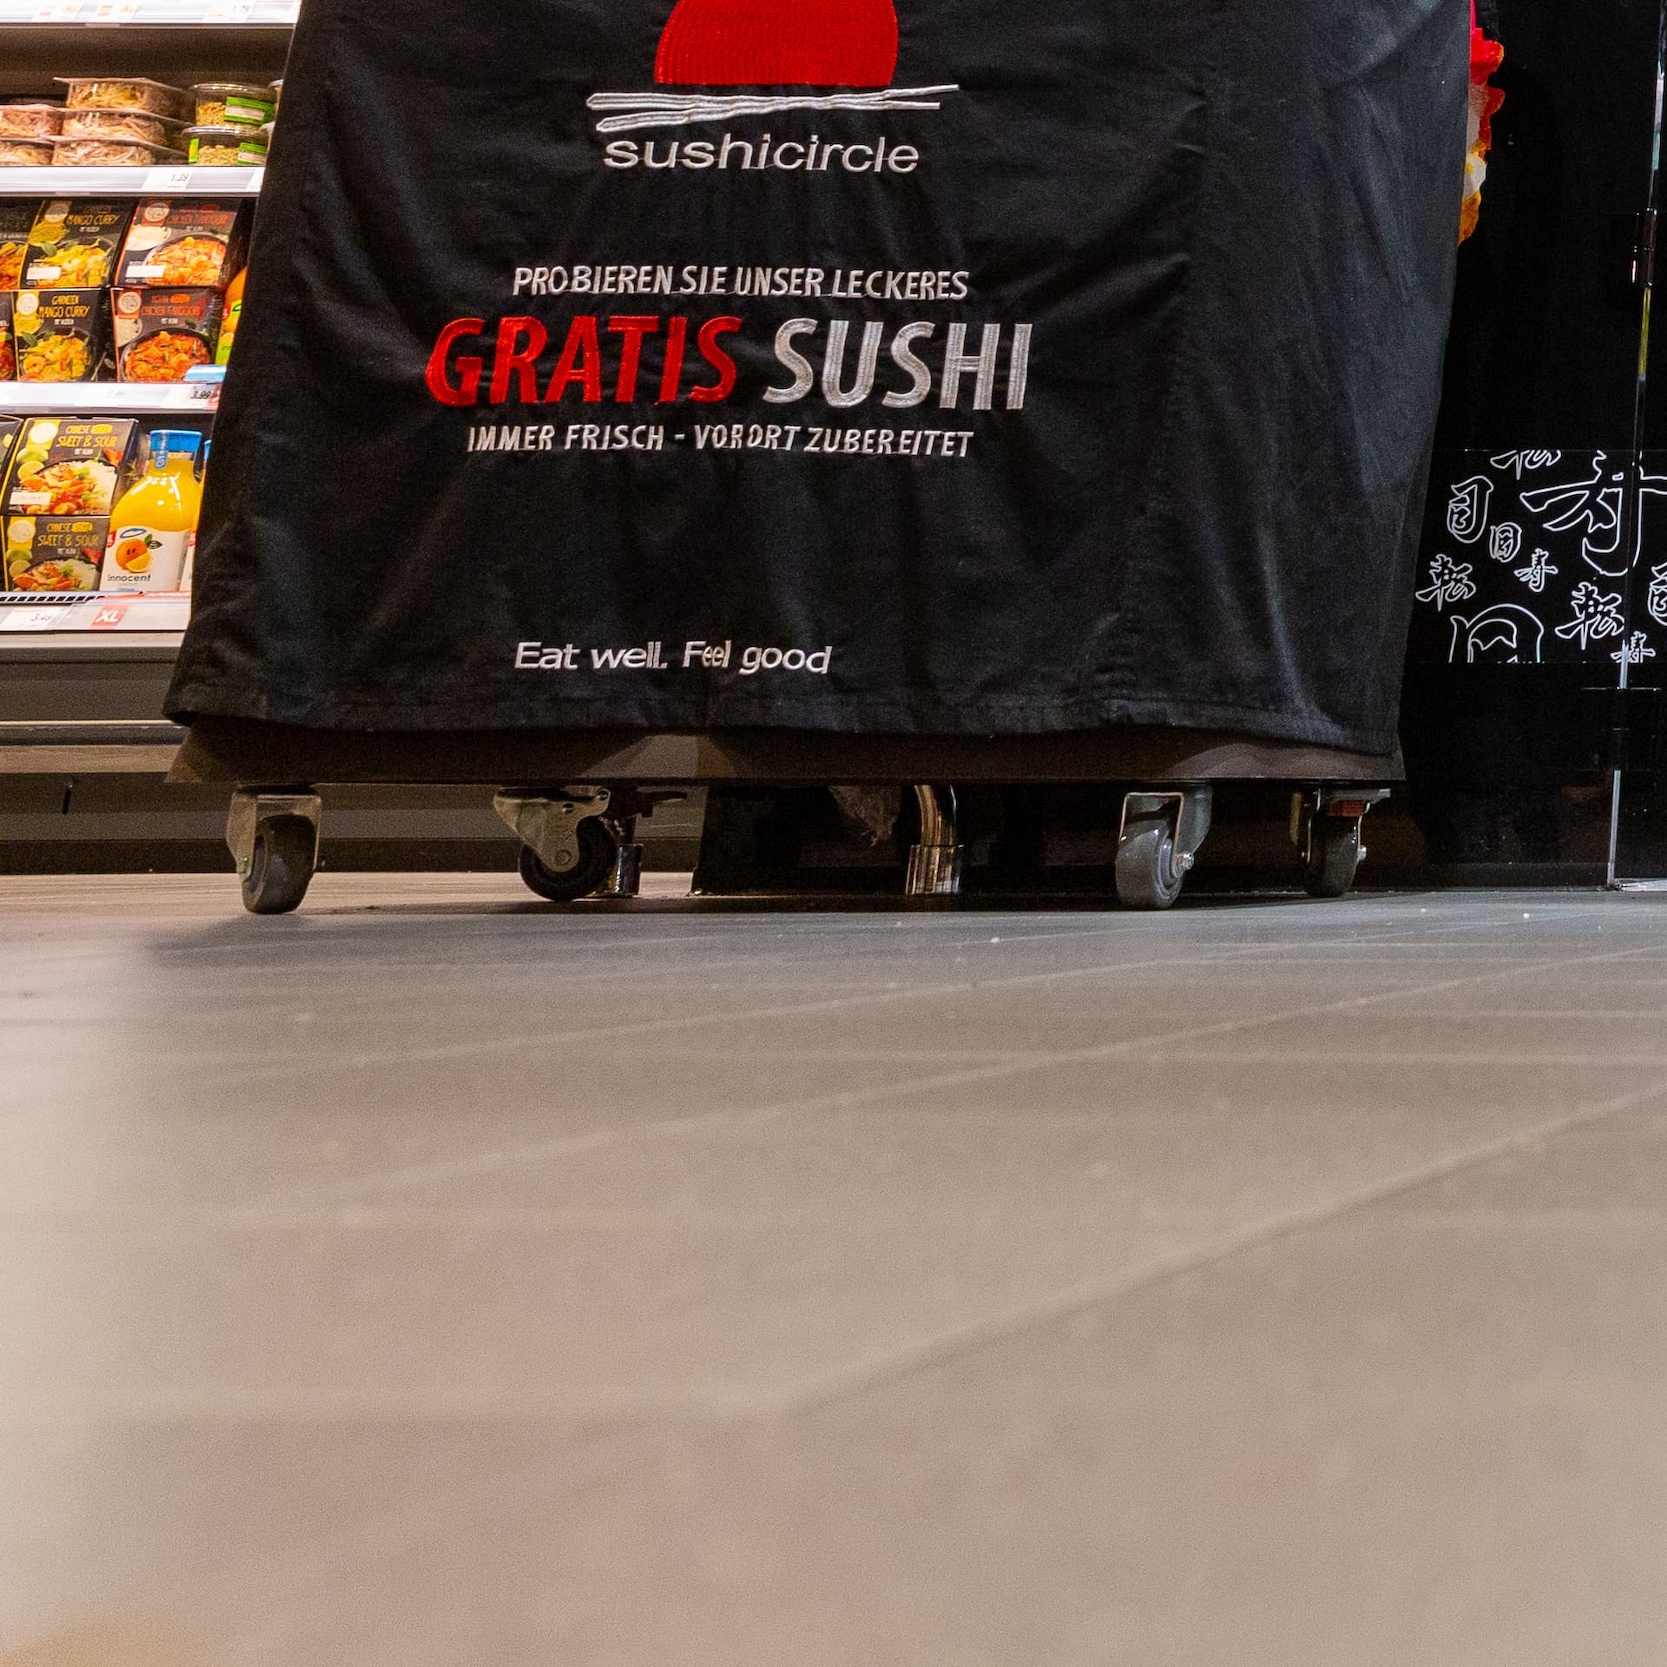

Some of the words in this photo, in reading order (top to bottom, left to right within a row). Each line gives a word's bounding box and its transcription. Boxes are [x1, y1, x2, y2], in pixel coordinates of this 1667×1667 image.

[603, 131, 920, 174] sushicircle
[512, 266, 672, 296] PROBIEREN
[678, 266, 727, 295] SIE
[735, 267, 823, 297] UNSER
[831, 269, 970, 301] LECKERES
[425, 315, 743, 408] GRATIS
[763, 318, 1033, 411] SUSHI
[467, 425, 555, 453] IMMER
[564, 424, 664, 451] FRISCH
[808, 427, 975, 458] ZUBEREITET
[107, 574, 151, 583] innocent
[95, 610, 120, 623] XL
[514, 640, 581, 670] Eat
[590, 640, 668, 670] well.
[684, 640, 732, 669] Feel
[739, 644, 832, 674] good
